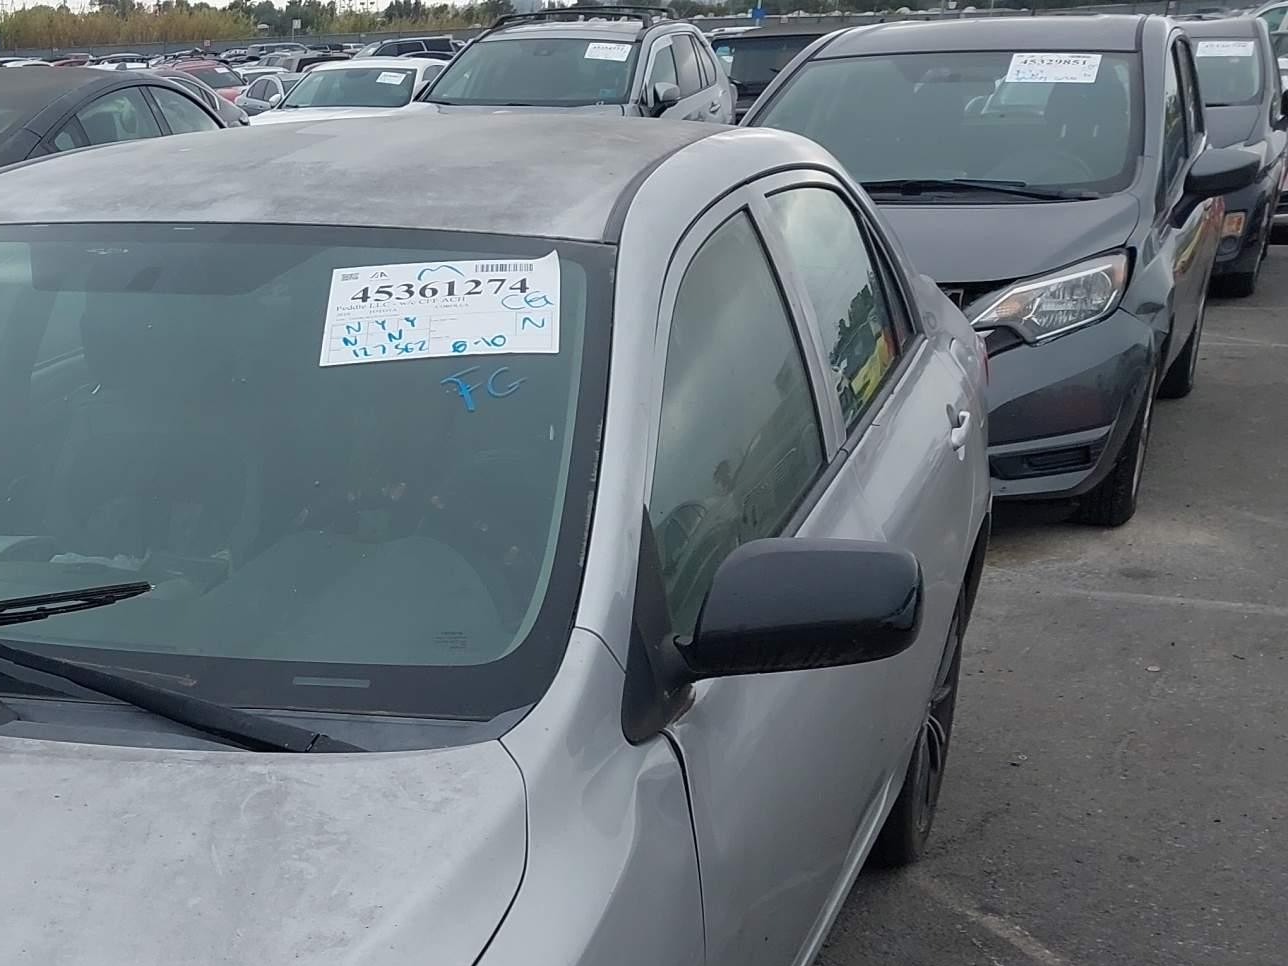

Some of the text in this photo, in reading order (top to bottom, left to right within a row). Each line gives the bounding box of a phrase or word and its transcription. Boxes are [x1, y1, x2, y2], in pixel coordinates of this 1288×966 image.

[351, 277, 530, 303] 45361274
[345, 321, 361, 335] N
[387, 328, 403, 343] N
